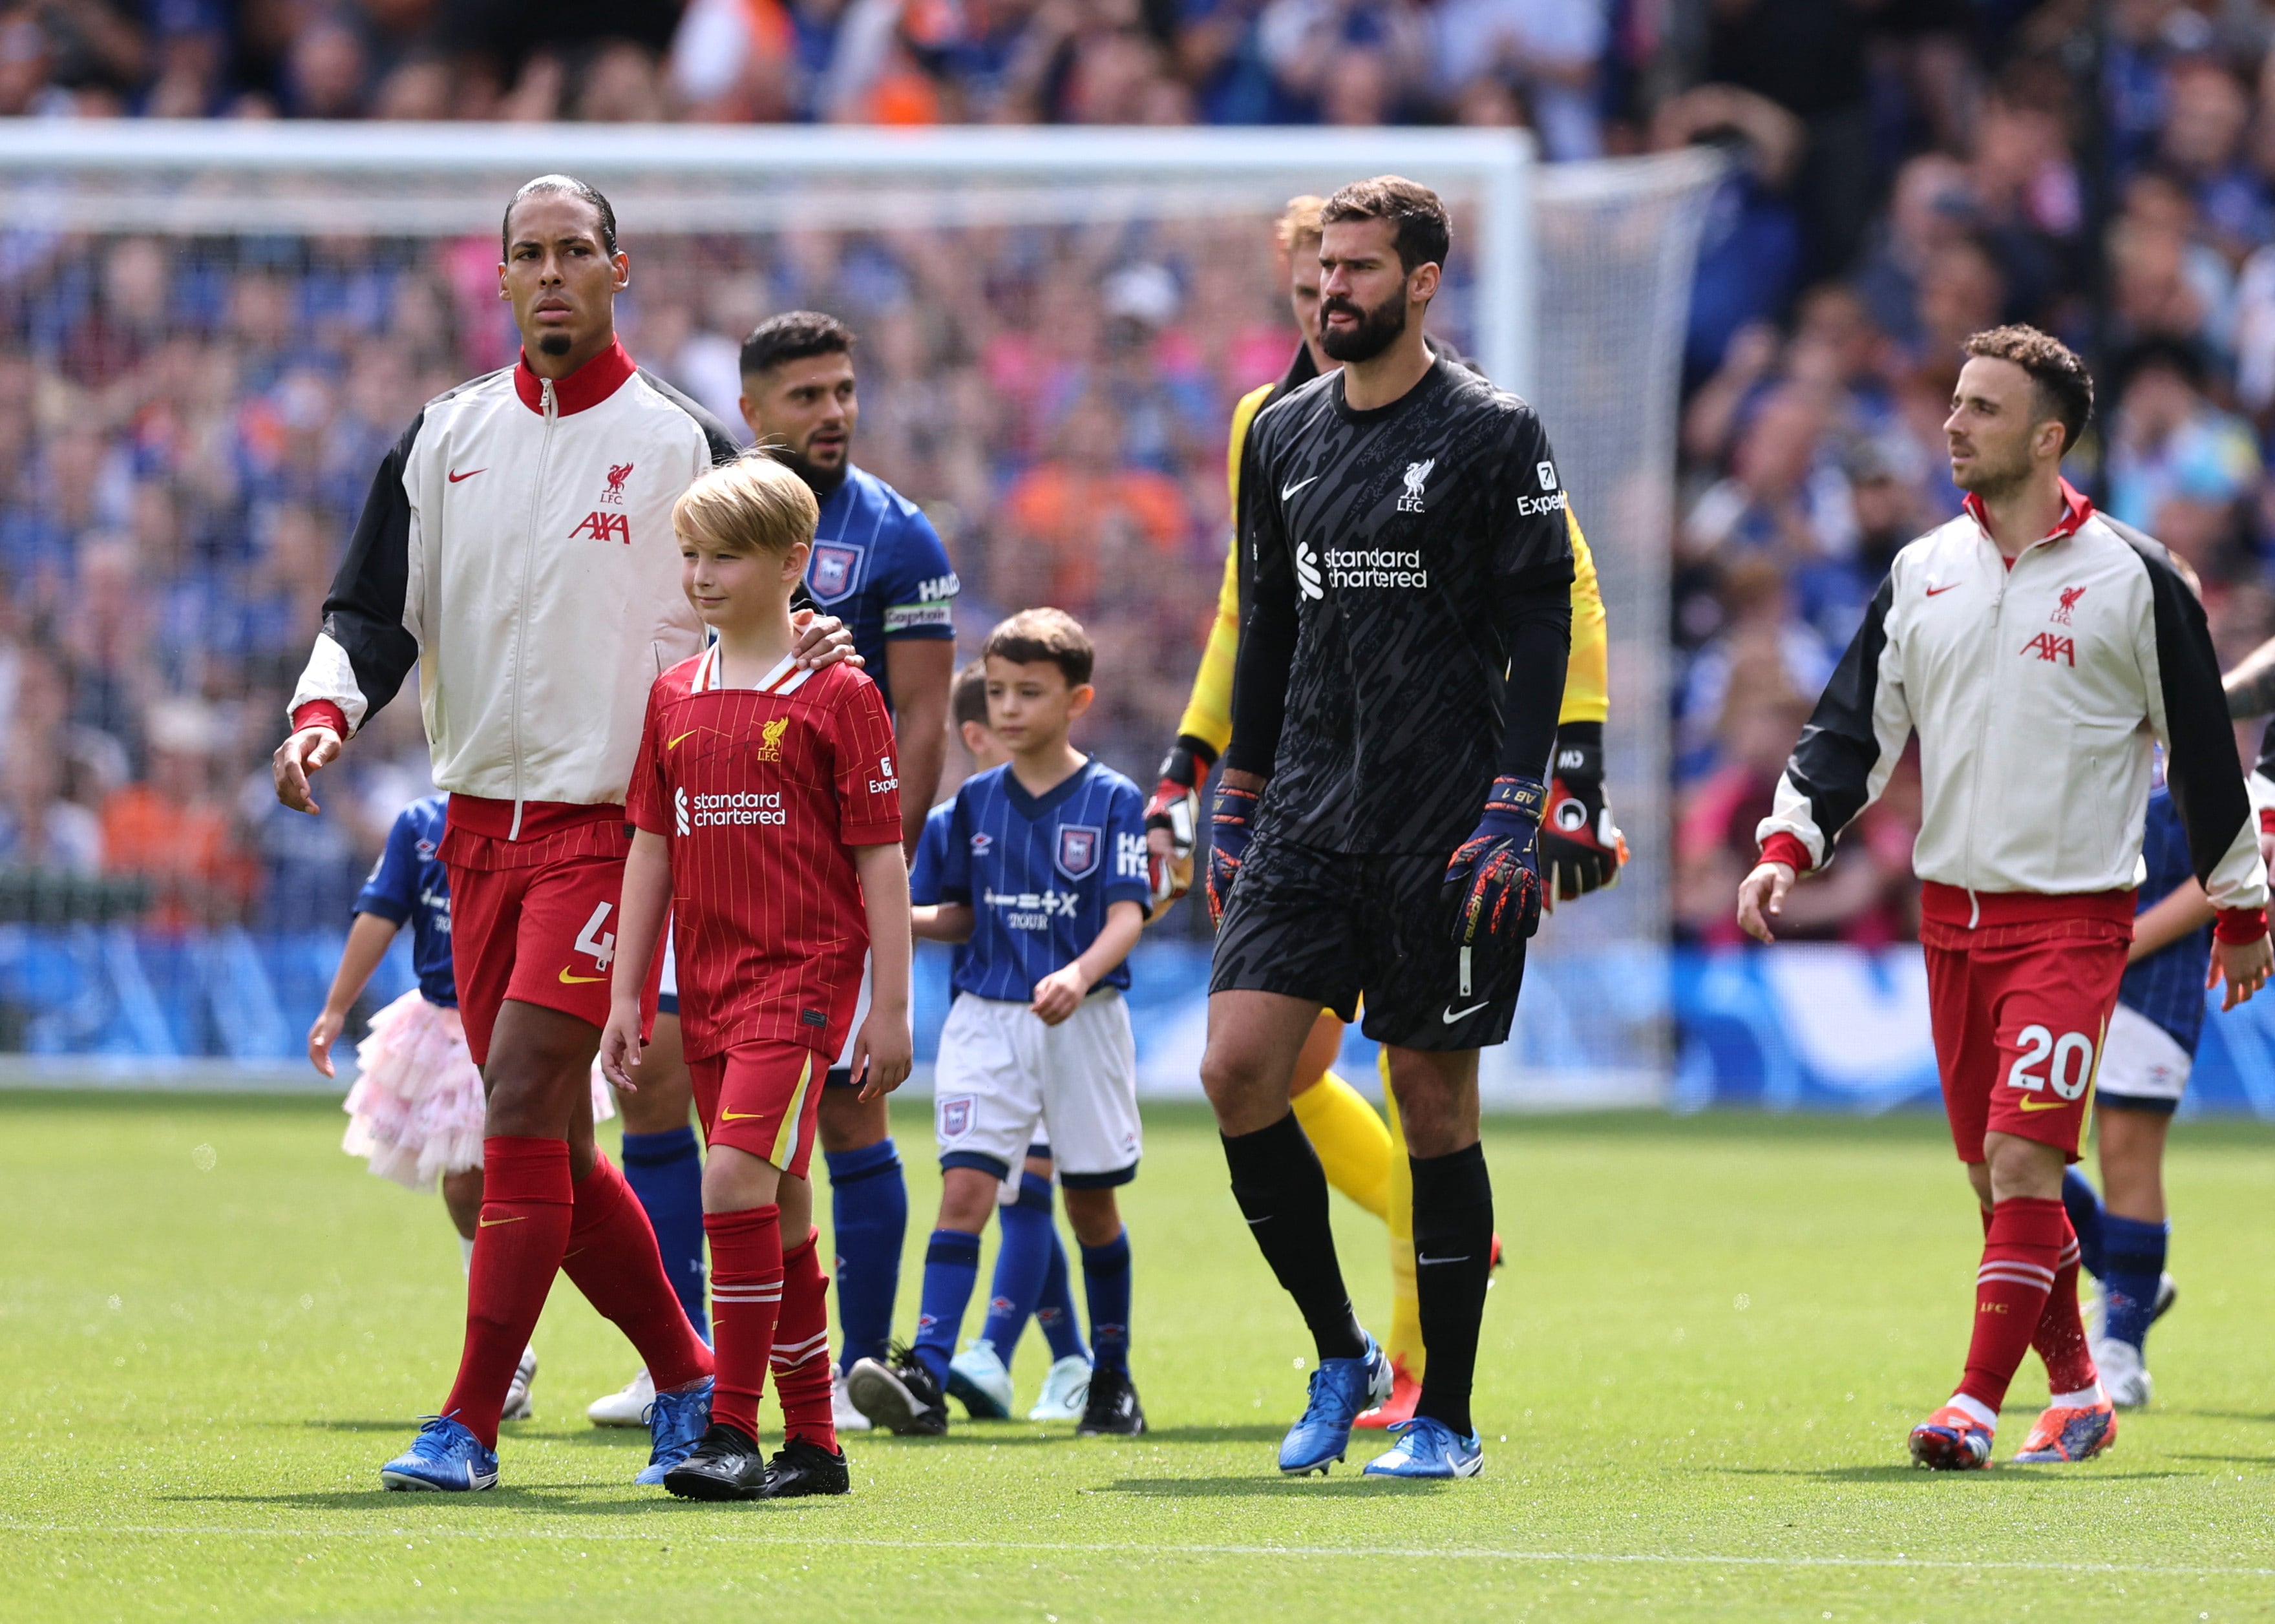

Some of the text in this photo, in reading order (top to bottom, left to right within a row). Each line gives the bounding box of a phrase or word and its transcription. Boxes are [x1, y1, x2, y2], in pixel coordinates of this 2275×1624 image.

[567, 511, 630, 545] AXA
[1324, 547, 1420, 569] standard
[1329, 568, 1427, 588] chartered
[2019, 632, 2075, 668] AXA
[693, 790, 780, 810] standard
[693, 808, 786, 827] chartered
[1008, 912, 1048, 930] TOUR
[573, 900, 615, 972] 4
[2007, 1024, 2093, 1101] 20
